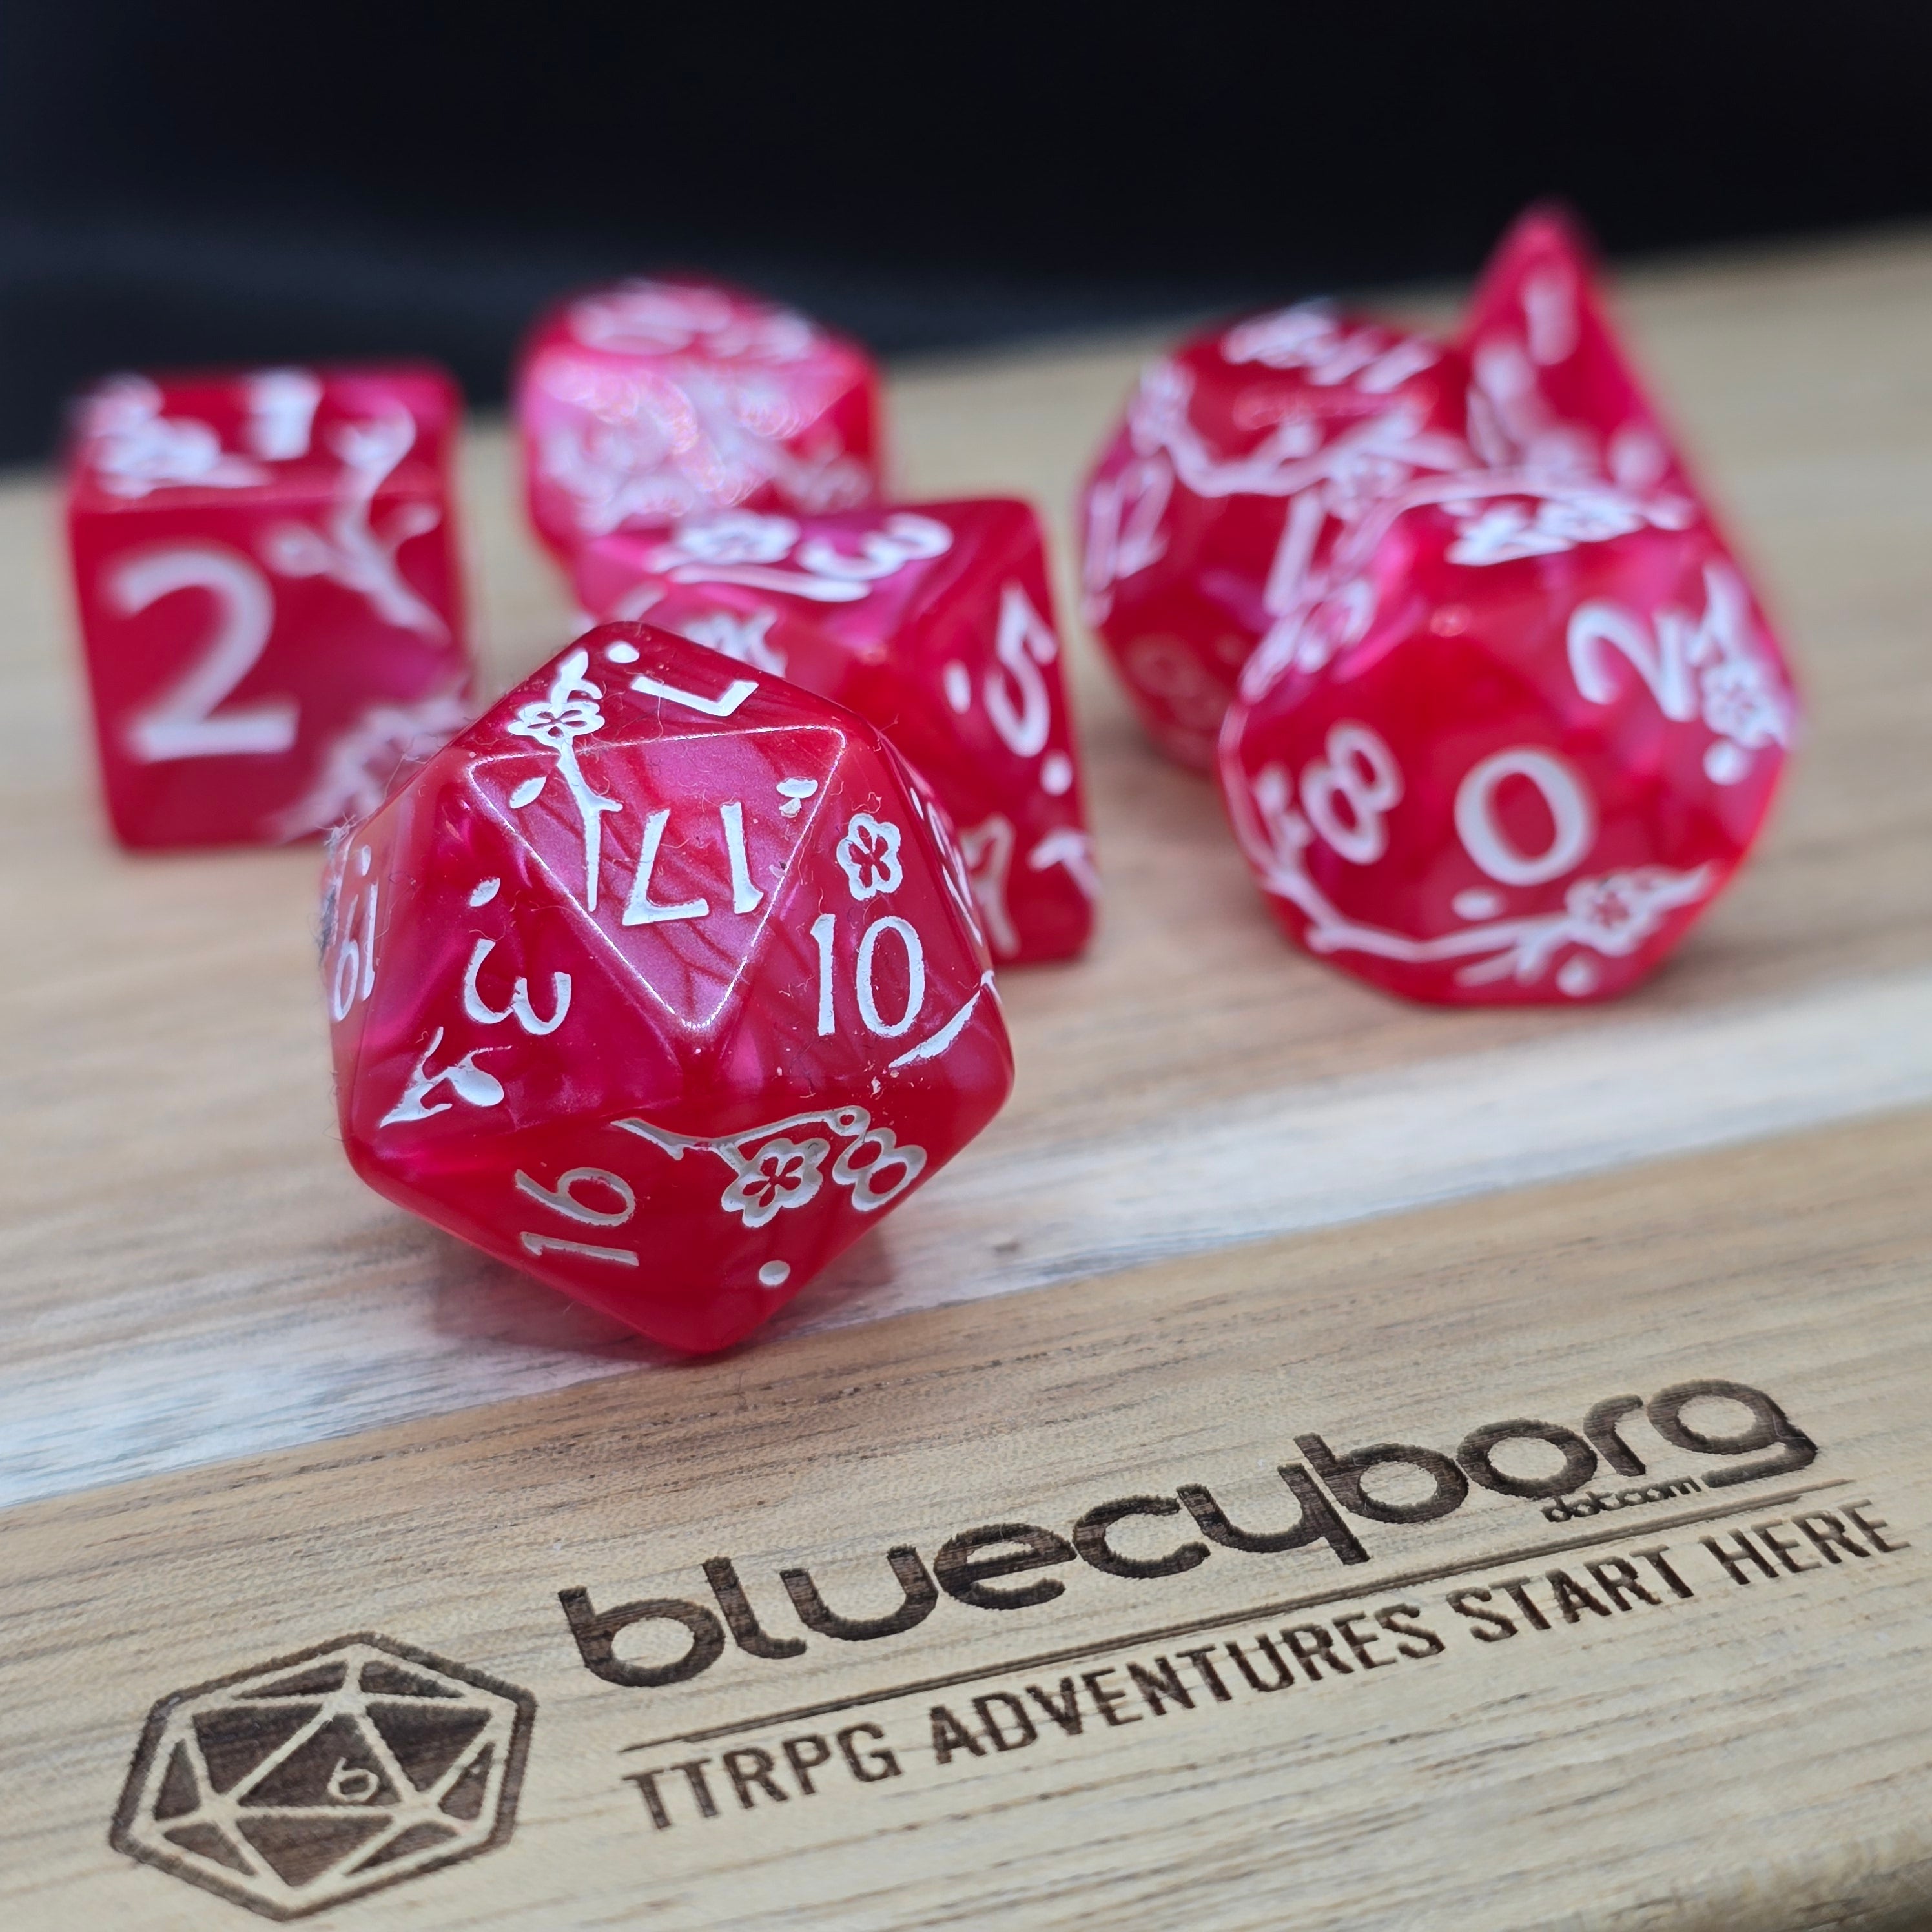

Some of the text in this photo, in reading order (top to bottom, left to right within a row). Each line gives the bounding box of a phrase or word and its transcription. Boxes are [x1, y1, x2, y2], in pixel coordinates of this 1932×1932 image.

[801, 513, 953, 581] 3
[105, 548, 297, 761] 2
[1566, 602, 1698, 722] 2
[1300, 720, 1403, 865] 8
[622, 802, 764, 926] 17
[463, 938, 572, 1034] 3
[810, 912, 925, 1036] 10
[516, 1166, 639, 1267] 16
[833, 1127, 927, 1212] 8
[559, 1379, 1818, 1687] bluecyborg
[622, 1501, 1911, 1829] TTRPG ADVENTURES START HERE
